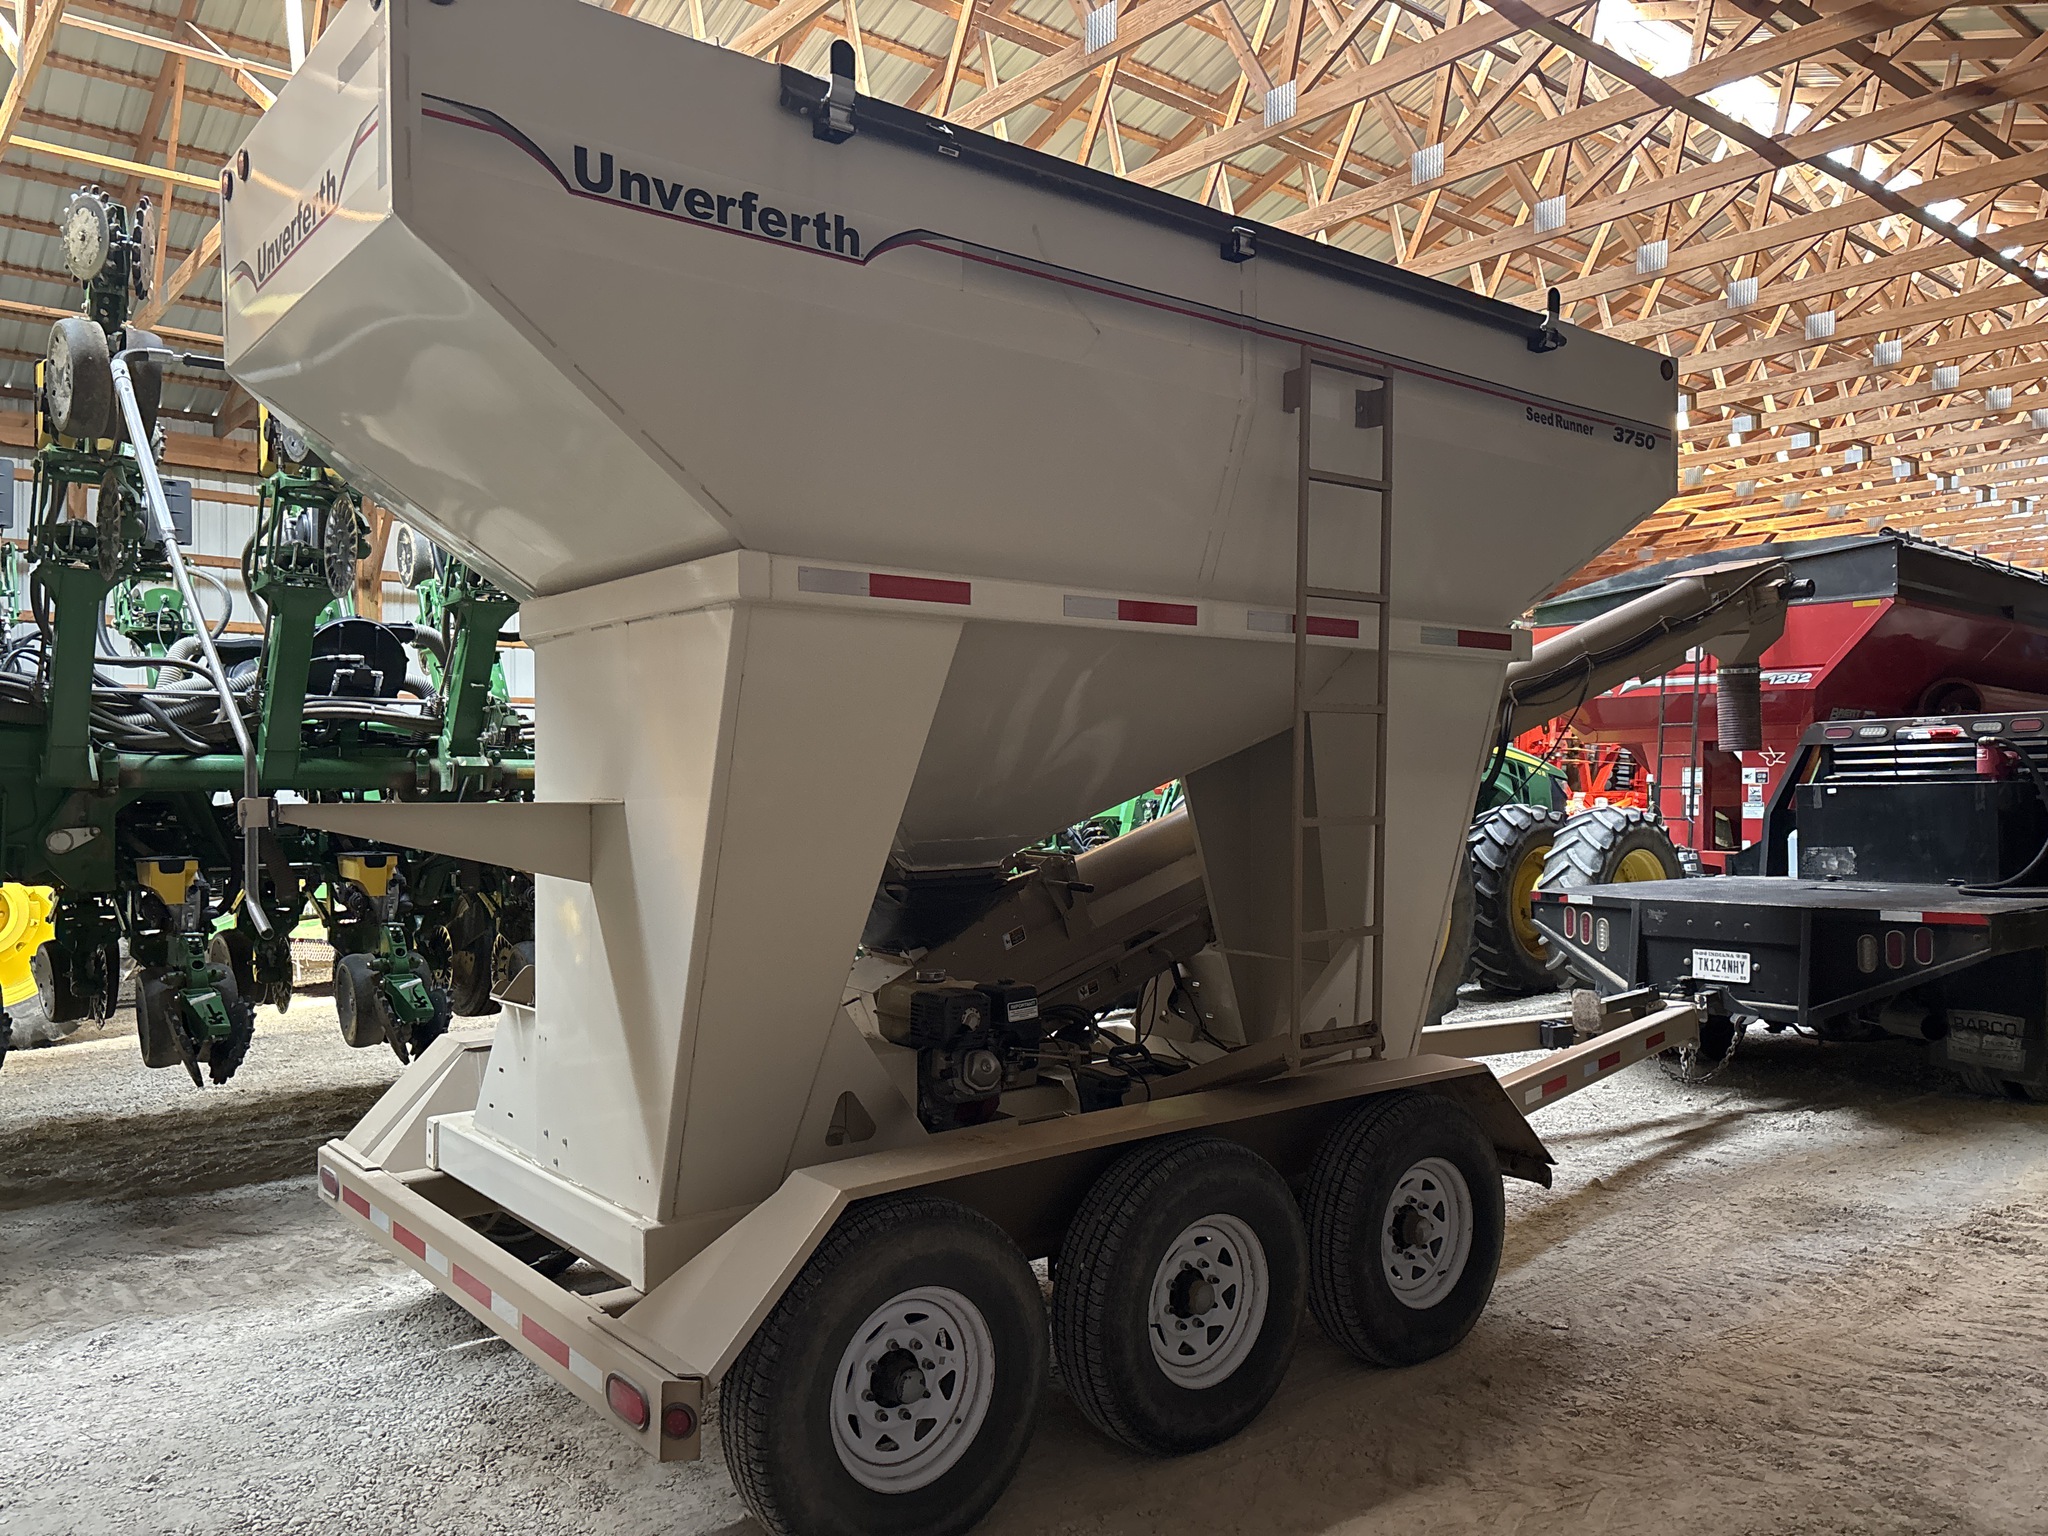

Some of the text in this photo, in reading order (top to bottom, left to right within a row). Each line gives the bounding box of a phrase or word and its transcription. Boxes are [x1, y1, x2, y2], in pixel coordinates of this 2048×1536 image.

[574, 145, 860, 258] Unverferth
[257, 168, 336, 283] Unverferth
[1526, 406, 1656, 450] Seed Runner 3750
[1768, 672, 1813, 685] 1282
[1698, 957, 1745, 974] TK124NHY
[1708, 951, 1735, 959] INDIANA
